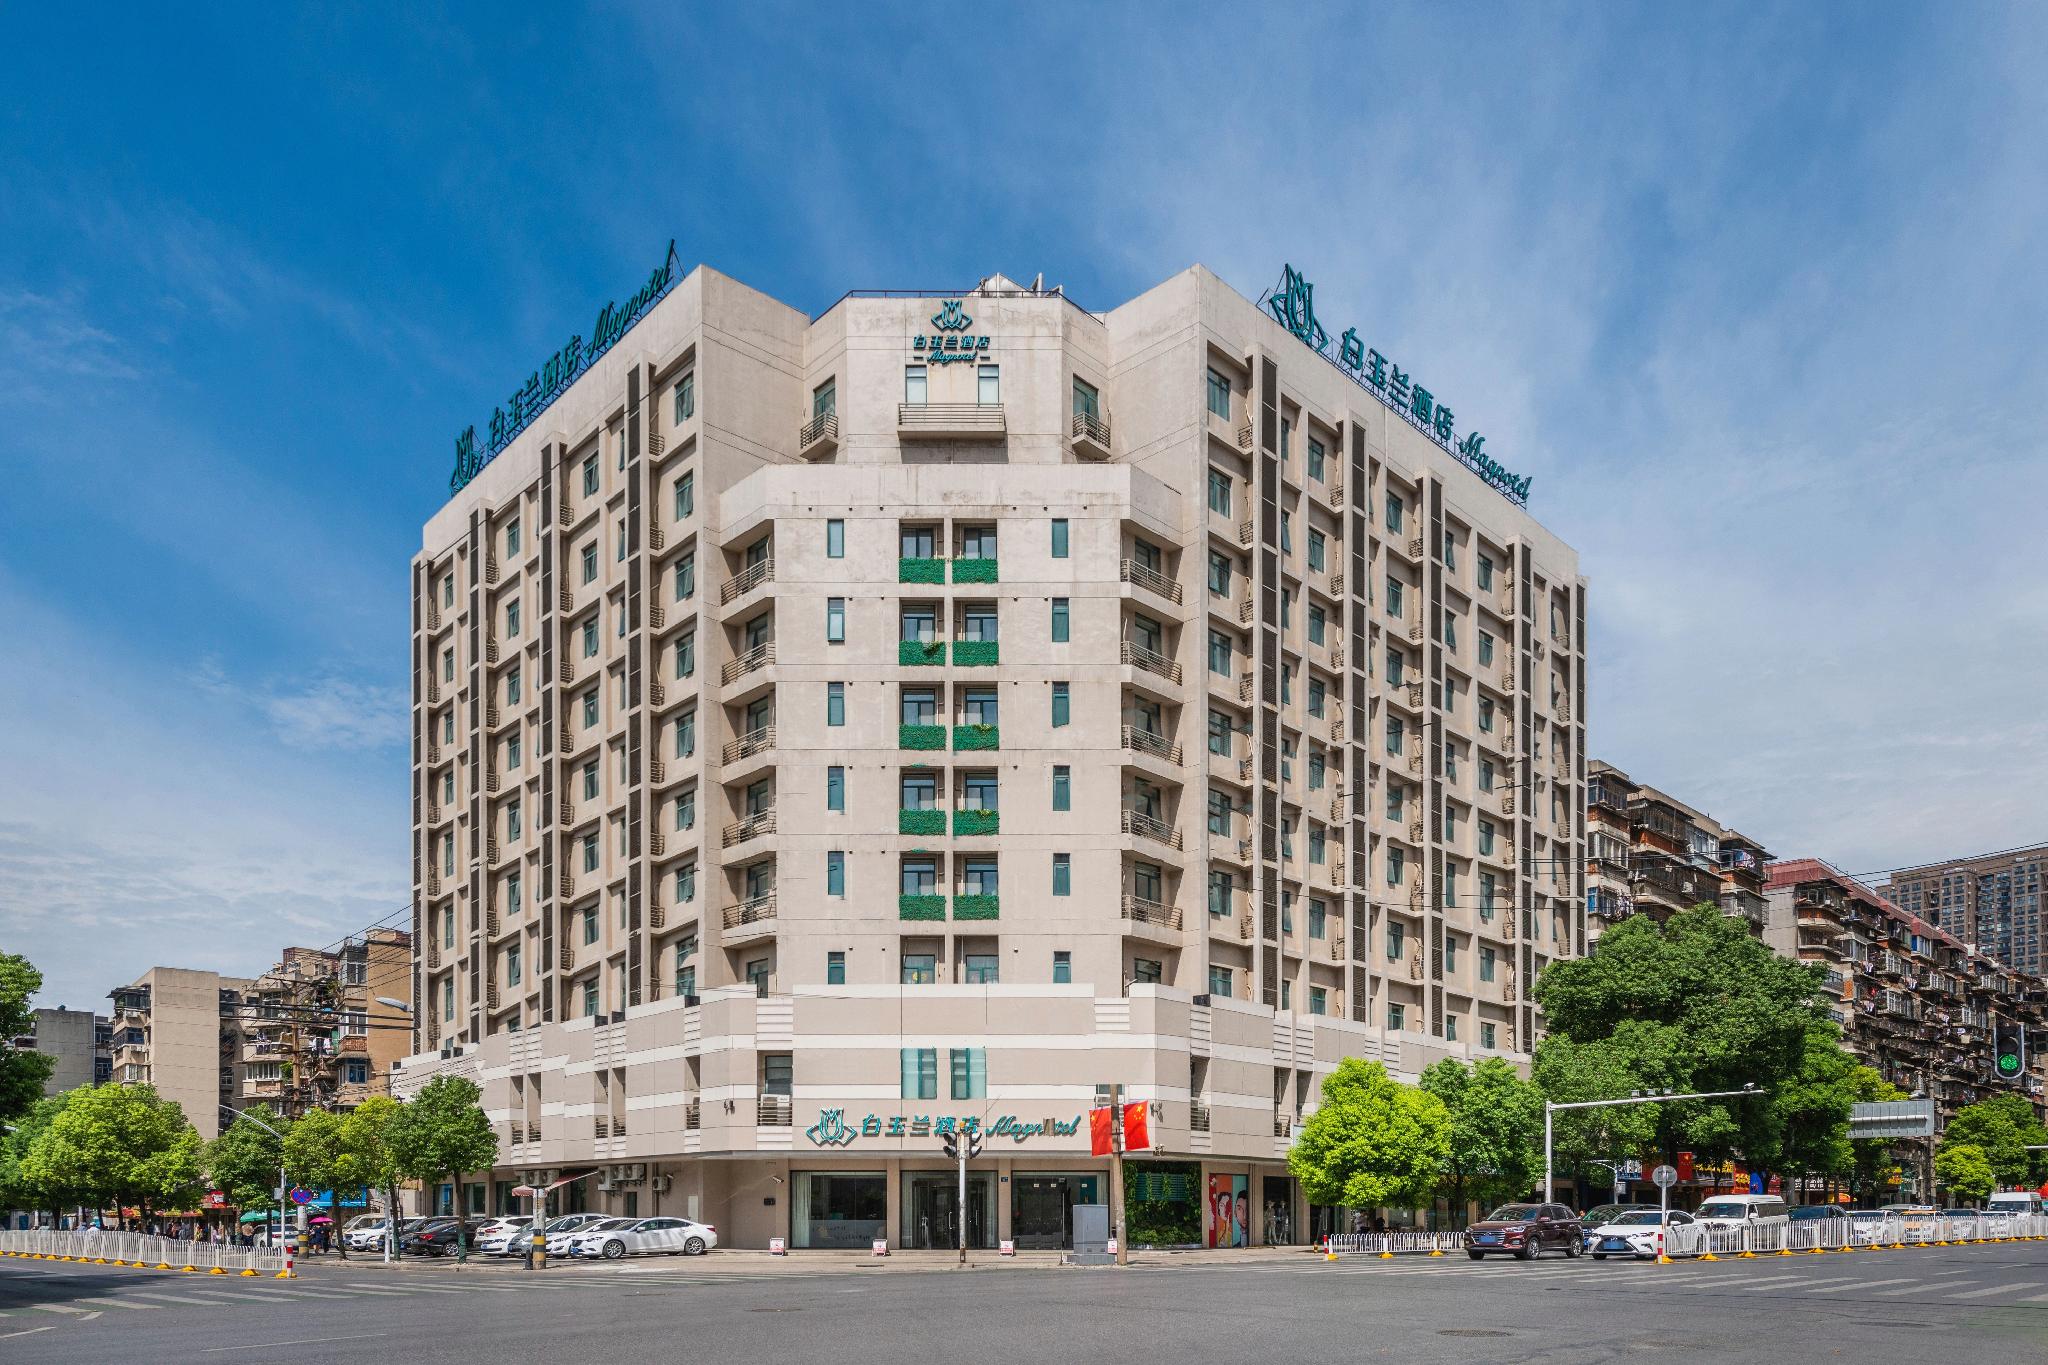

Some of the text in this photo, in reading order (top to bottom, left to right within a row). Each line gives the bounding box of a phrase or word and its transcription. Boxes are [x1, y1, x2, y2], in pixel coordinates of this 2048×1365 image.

[913, 334, 990, 350] 白玉兰酒店
[1341, 327, 1532, 500] 白玉兰酒店 Magnotel
[985, 1115, 1082, 1144] Magntel
